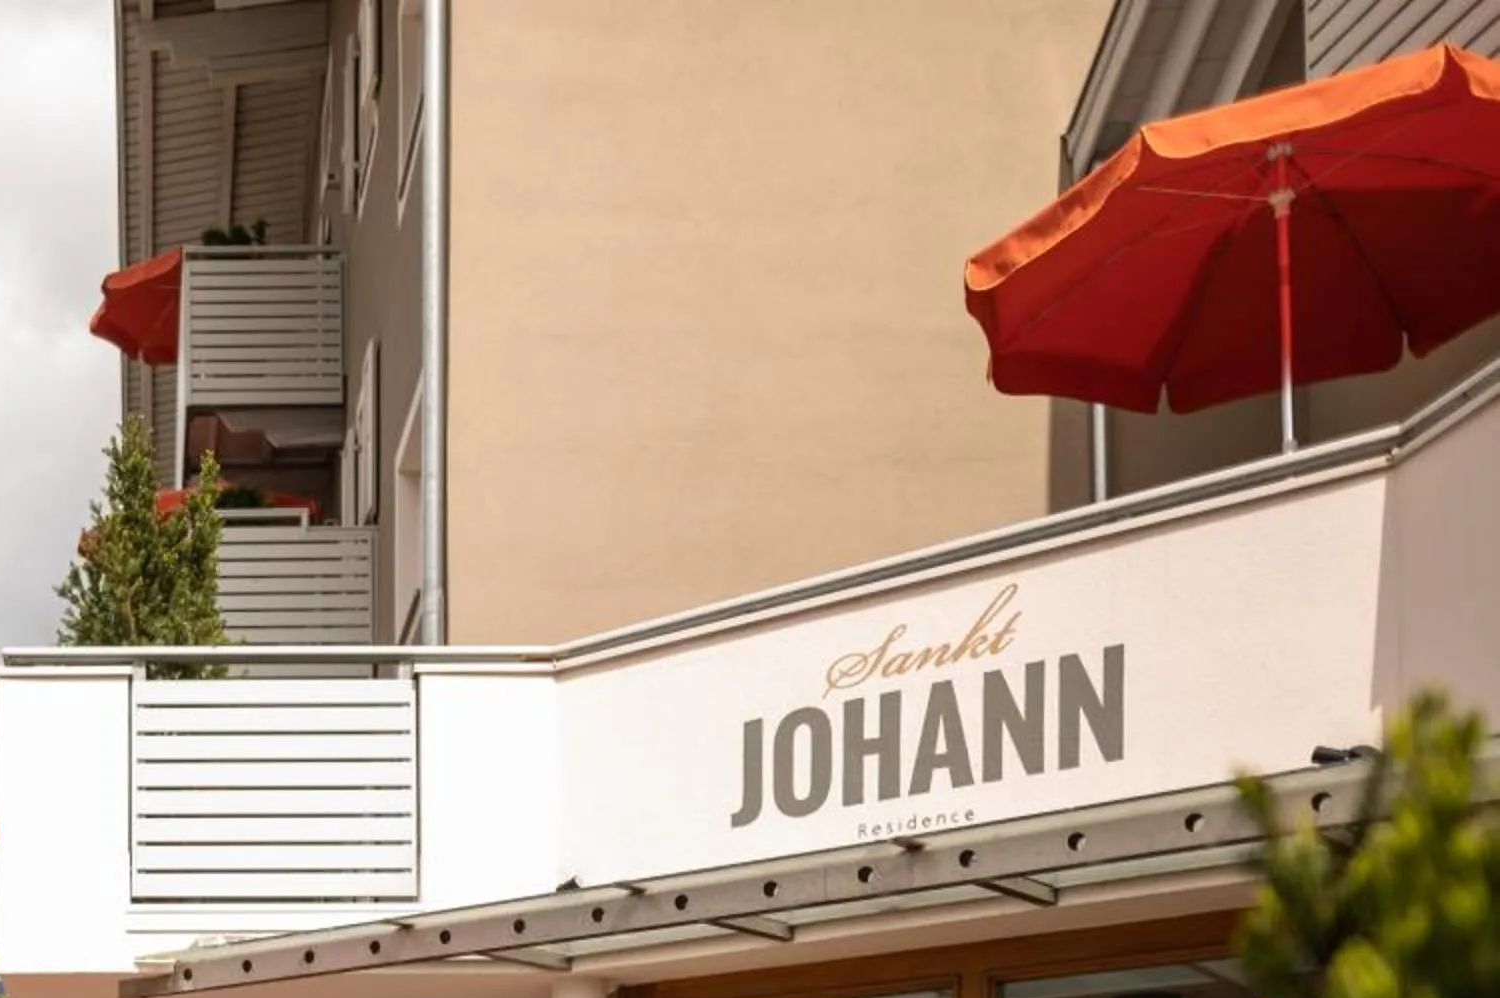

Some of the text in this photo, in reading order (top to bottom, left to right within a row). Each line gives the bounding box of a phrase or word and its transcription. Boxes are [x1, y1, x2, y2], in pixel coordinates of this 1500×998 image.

[822, 583, 1022, 699] Sankt
[730, 643, 1125, 829] JOHANN
[857, 809, 976, 838] Residence
